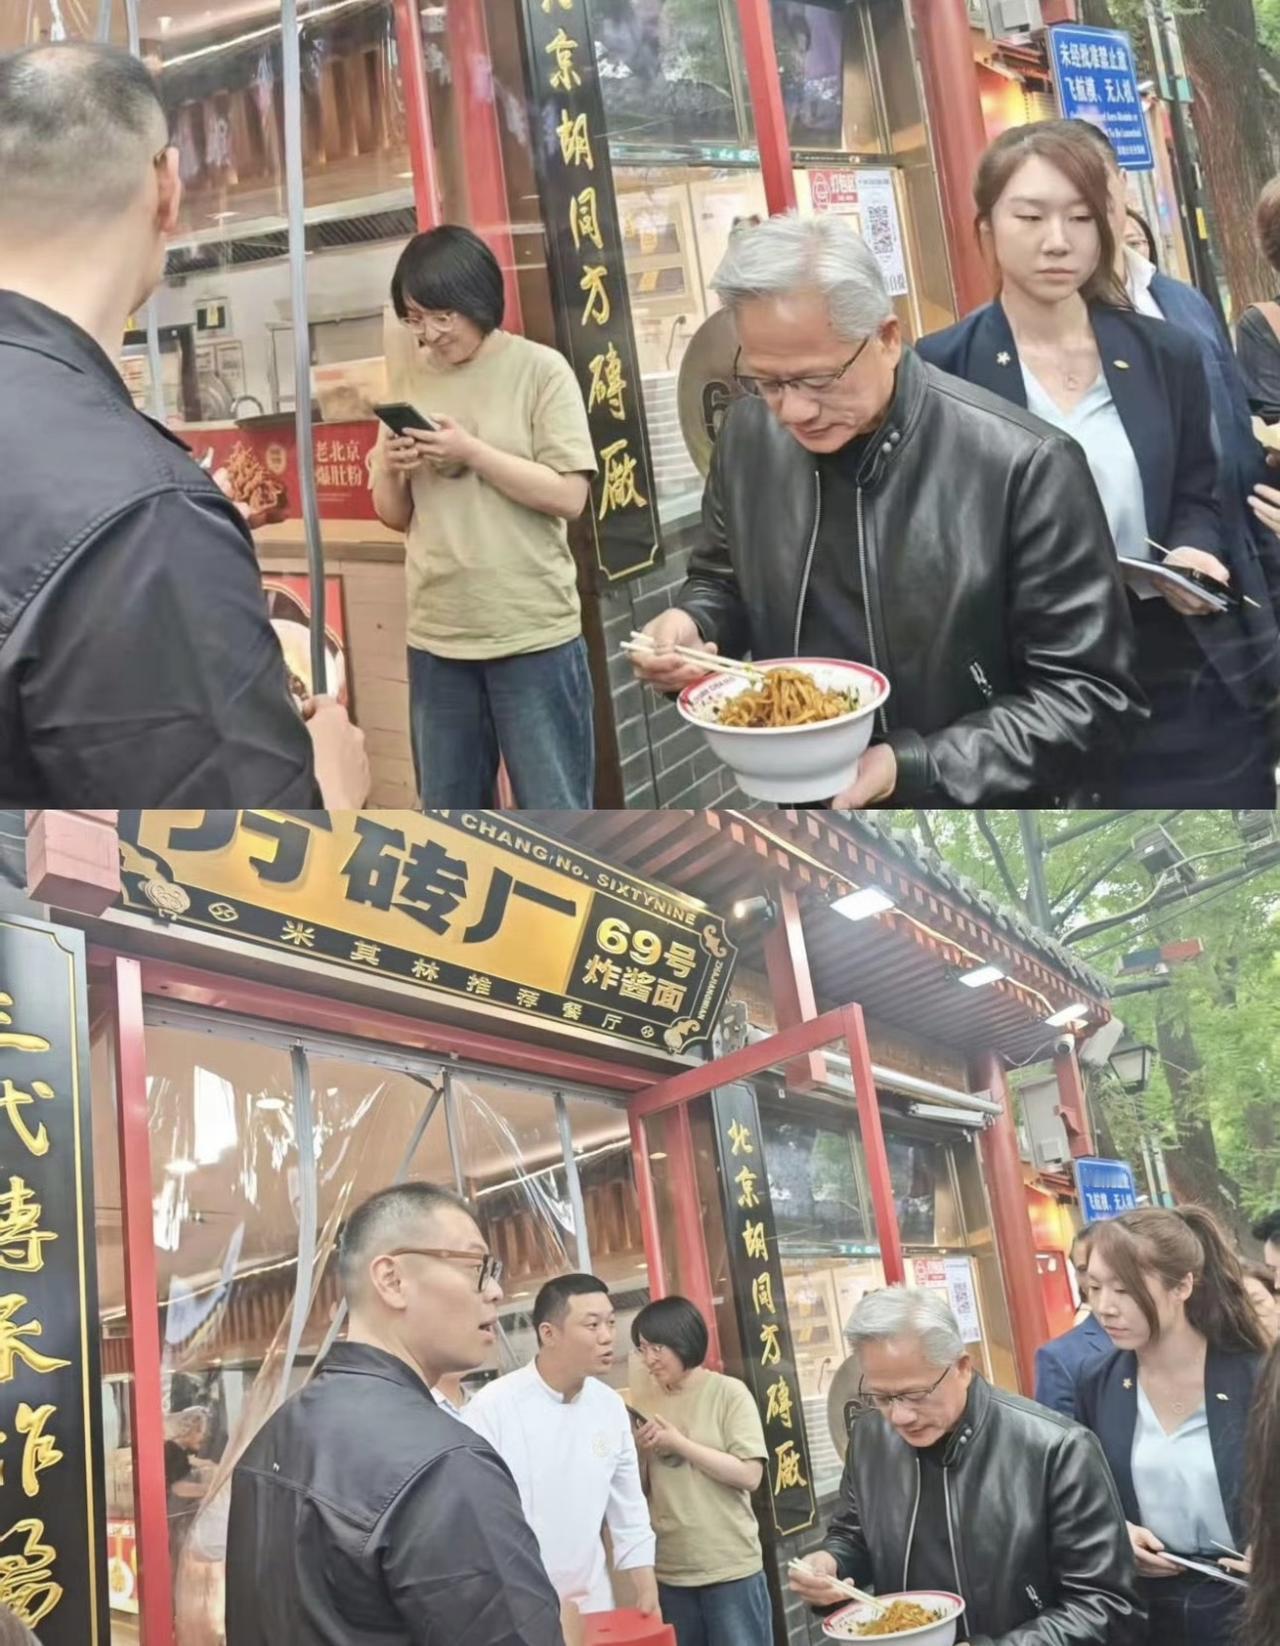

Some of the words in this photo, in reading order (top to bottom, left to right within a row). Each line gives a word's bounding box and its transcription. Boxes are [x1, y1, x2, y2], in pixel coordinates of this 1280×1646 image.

[316, 440, 361, 462] 老北京
[596, 873, 697, 926] SIXTYNINE
[280, 920, 622, 1031] 米其林推荐餐厅
[596, 917, 698, 978] 69号
